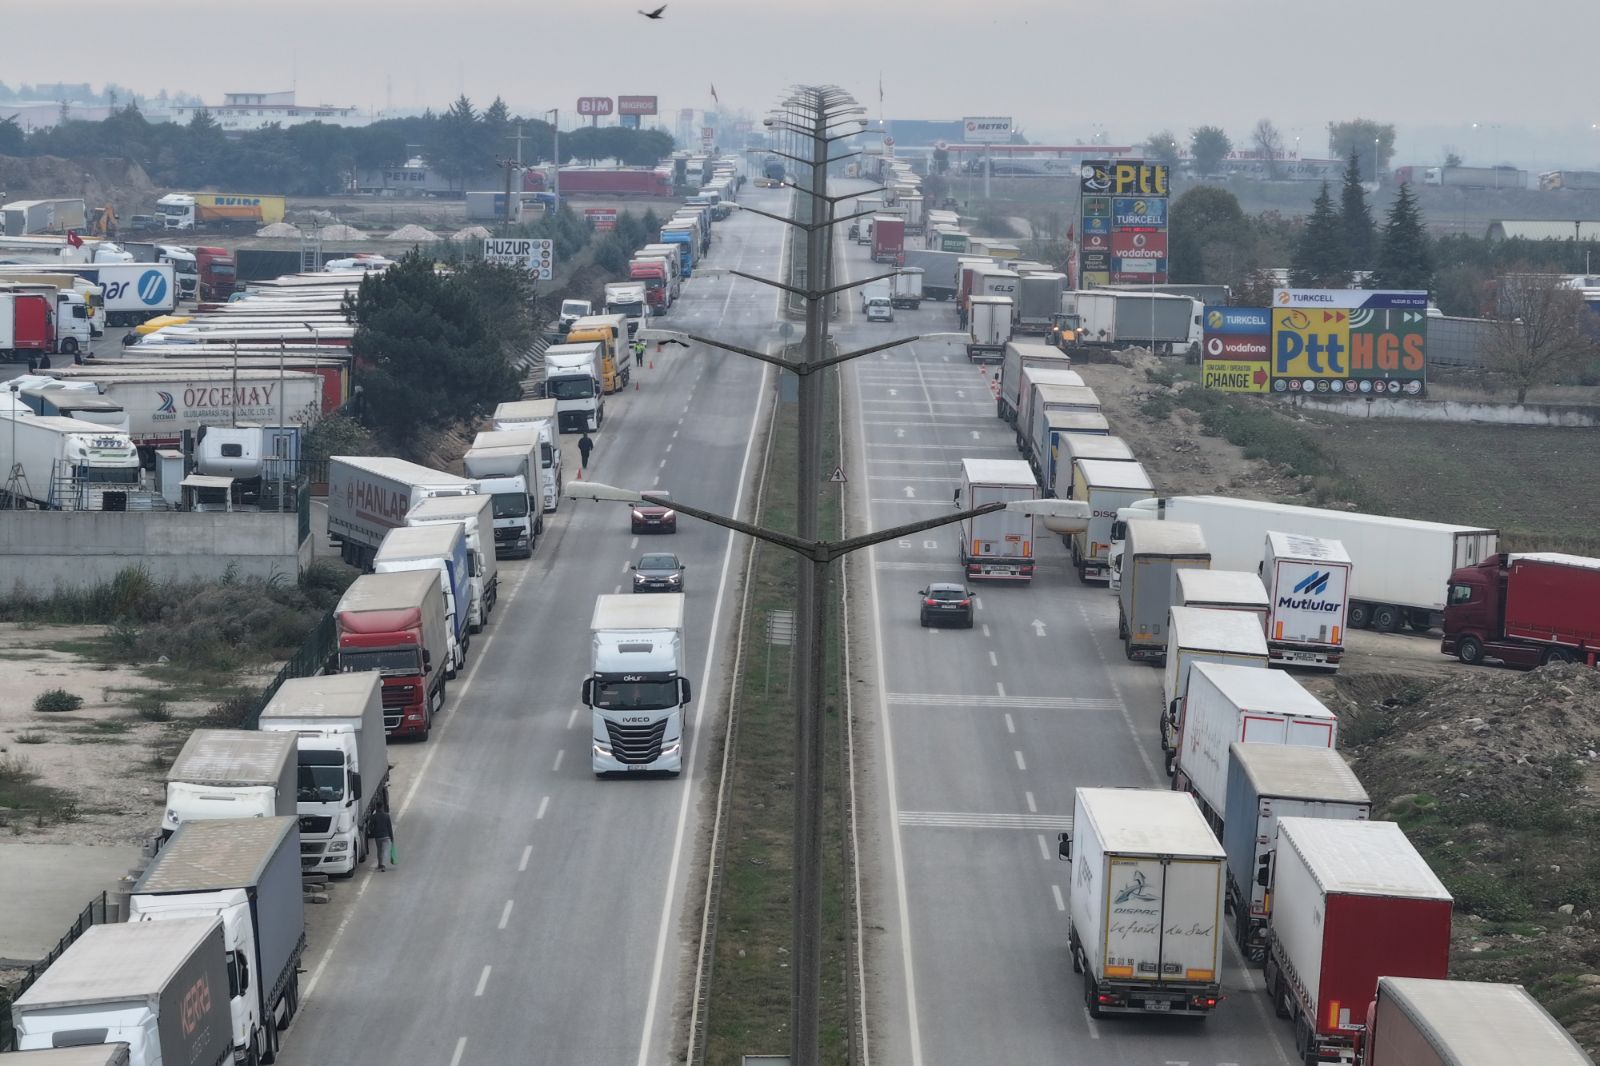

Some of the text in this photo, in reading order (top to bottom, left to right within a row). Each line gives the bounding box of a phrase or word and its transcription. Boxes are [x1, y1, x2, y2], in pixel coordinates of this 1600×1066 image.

[1116, 165, 1167, 193] Ptt
[1117, 215, 1163, 224] TURKCELL
[486, 241, 531, 255] HUZUR
[1116, 248, 1164, 258] vodafone
[1292, 294, 1334, 302] TURKCELL
[1226, 316, 1266, 325] TURKCELL
[1226, 343, 1266, 353] vodafone
[1277, 331, 1424, 373] Ptt HGS
[1206, 373, 1249, 388] CHANGE
[183, 382, 276, 408] ÖZCEMAY
[1278, 597, 1341, 612] Mutlular
